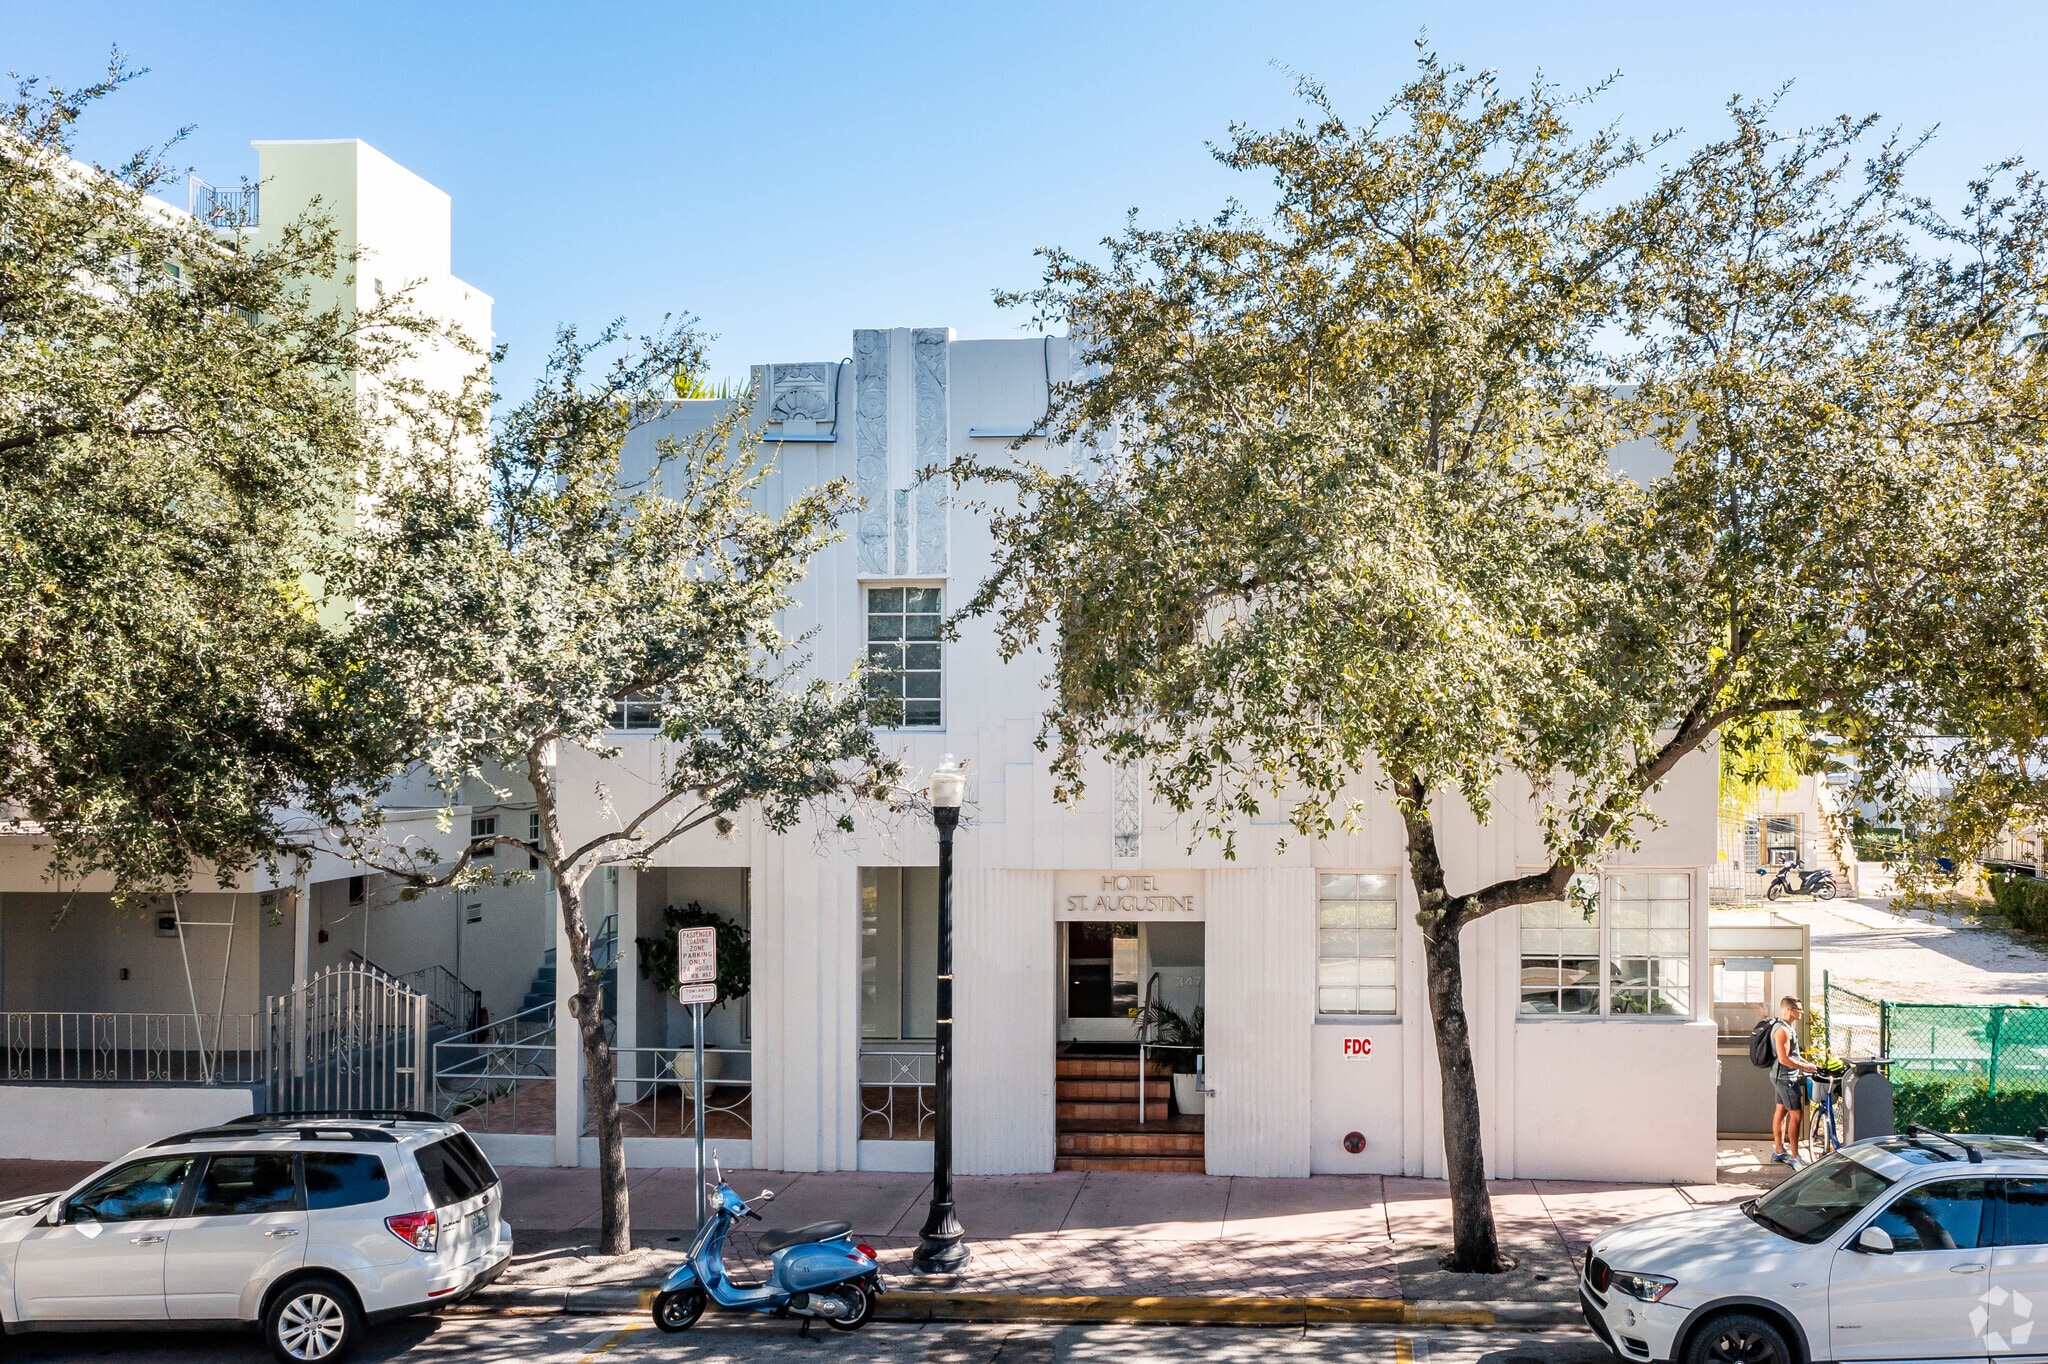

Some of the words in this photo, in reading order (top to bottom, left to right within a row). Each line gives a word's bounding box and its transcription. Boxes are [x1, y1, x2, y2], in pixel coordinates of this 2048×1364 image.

[1101, 875, 1159, 892] HOTEL
[1067, 895, 1088, 912] ST.
[1094, 895, 1194, 912] AUGUSTINE
[1344, 1038, 1371, 1055] FDC
